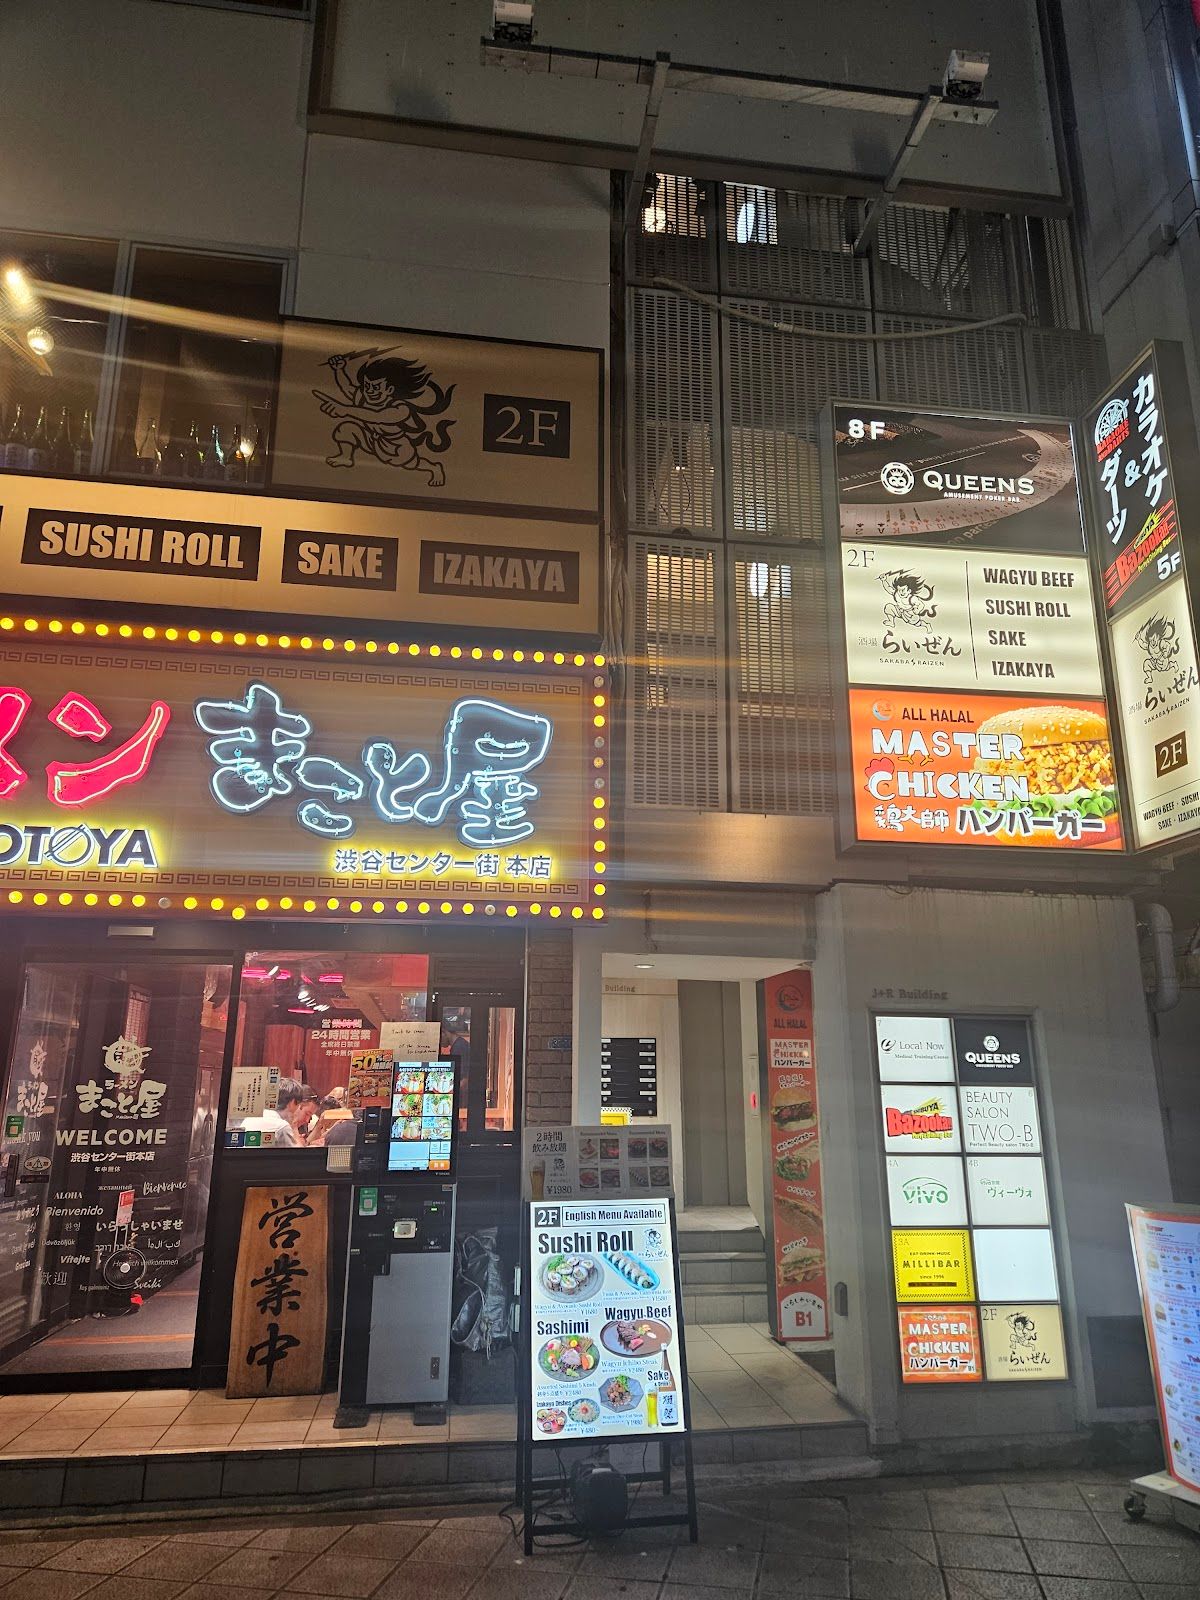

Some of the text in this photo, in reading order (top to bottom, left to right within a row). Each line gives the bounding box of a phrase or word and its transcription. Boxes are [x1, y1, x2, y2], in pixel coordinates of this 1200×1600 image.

[495, 406, 559, 448] 2F
[848, 418, 886, 440] 8F
[1133, 373, 1168, 508] カラオケ
[1124, 459, 1142, 488] &
[922, 470, 1035, 496] QUEENS
[943, 491, 983, 501] AMUSEMENT
[984, 494, 1006, 502] POKER
[1101, 447, 1128, 546] ダーツ
[39, 520, 244, 570] SUSHI ROLL
[296, 541, 384, 580] SAKE
[847, 548, 876, 568] 2F
[1157, 551, 1182, 580] 5F
[432, 552, 567, 593] IZAKAYA
[983, 567, 1076, 588] WAGYU BEEF
[985, 599, 1072, 618] SUSHI ROLL
[881, 629, 963, 657] らいぜん
[988, 629, 1028, 647] SAKE
[879, 657, 946, 667] SAKABA RAIZEN
[991, 660, 1056, 679] IZAKAYA
[1144, 666, 1199, 712] らいぜん
[901, 707, 927, 722] ALL
[930, 708, 975, 724] HALAL
[1143, 696, 1191, 725] SAKABA RAIZEN
[871, 727, 1026, 762] MASTER
[194, 679, 554, 848] まこと屋
[1159, 738, 1183, 772] 2F
[868, 769, 1031, 803] CHICKEN
[1142, 791, 1200, 822] WAGYU BEEF SUSHI
[955, 806, 1107, 840] ハンバーガー
[1157, 816, 1173, 831] SAKE
[334, 848, 553, 880] 渋谷センター街 本店
[604, 984, 637, 993] Building
[871, 987, 949, 1001] J+R Building
[311, 1029, 371, 1041] 24時間営業
[774, 1041, 809, 1049] MASTER
[899, 1041, 945, 1051] Local Now
[774, 1059, 811, 1068] ハンバーガー
[965, 1051, 1021, 1064] QUEENS
[75, 1080, 167, 1119] まこと屋
[965, 1091, 1013, 1104] BEAUTY
[966, 1106, 1010, 1119] SALON
[56, 1128, 168, 1146] WELCOME
[536, 1131, 564, 1142] 2時間
[967, 1123, 1034, 1142] TWO-B
[532, 1142, 568, 1153] 飲み放題
[70, 1151, 156, 1163] 渋谷センター街本店
[94, 1165, 121, 1173] 年中無休
[53, 1191, 84, 1200] ALOHA
[546, 1185, 573, 1195] ¥1980
[987, 1186, 1033, 1198] ヴィーヴォ
[45, 1204, 105, 1218] Bienvenido
[537, 1209, 559, 1226] 2F
[565, 1208, 664, 1222] English Menu Available
[538, 1230, 634, 1255] Sushi Roll
[902, 1260, 961, 1269] MILLIBAR
[247, 1190, 315, 1389] 営業中
[604, 1305, 672, 1321] Wagyu Beef
[795, 1311, 812, 1327] B1
[982, 1308, 998, 1321] 2F
[537, 1319, 590, 1336] Sashimi
[908, 1322, 968, 1336] MASTER
[908, 1341, 970, 1356] CHICKEN
[601, 1360, 622, 1368] Wagyu
[910, 1357, 969, 1369] ハンバーガー
[1008, 1350, 1051, 1366] らいぜん
[647, 1370, 669, 1381] Sake
[555, 1399, 572, 1407] Dishes
